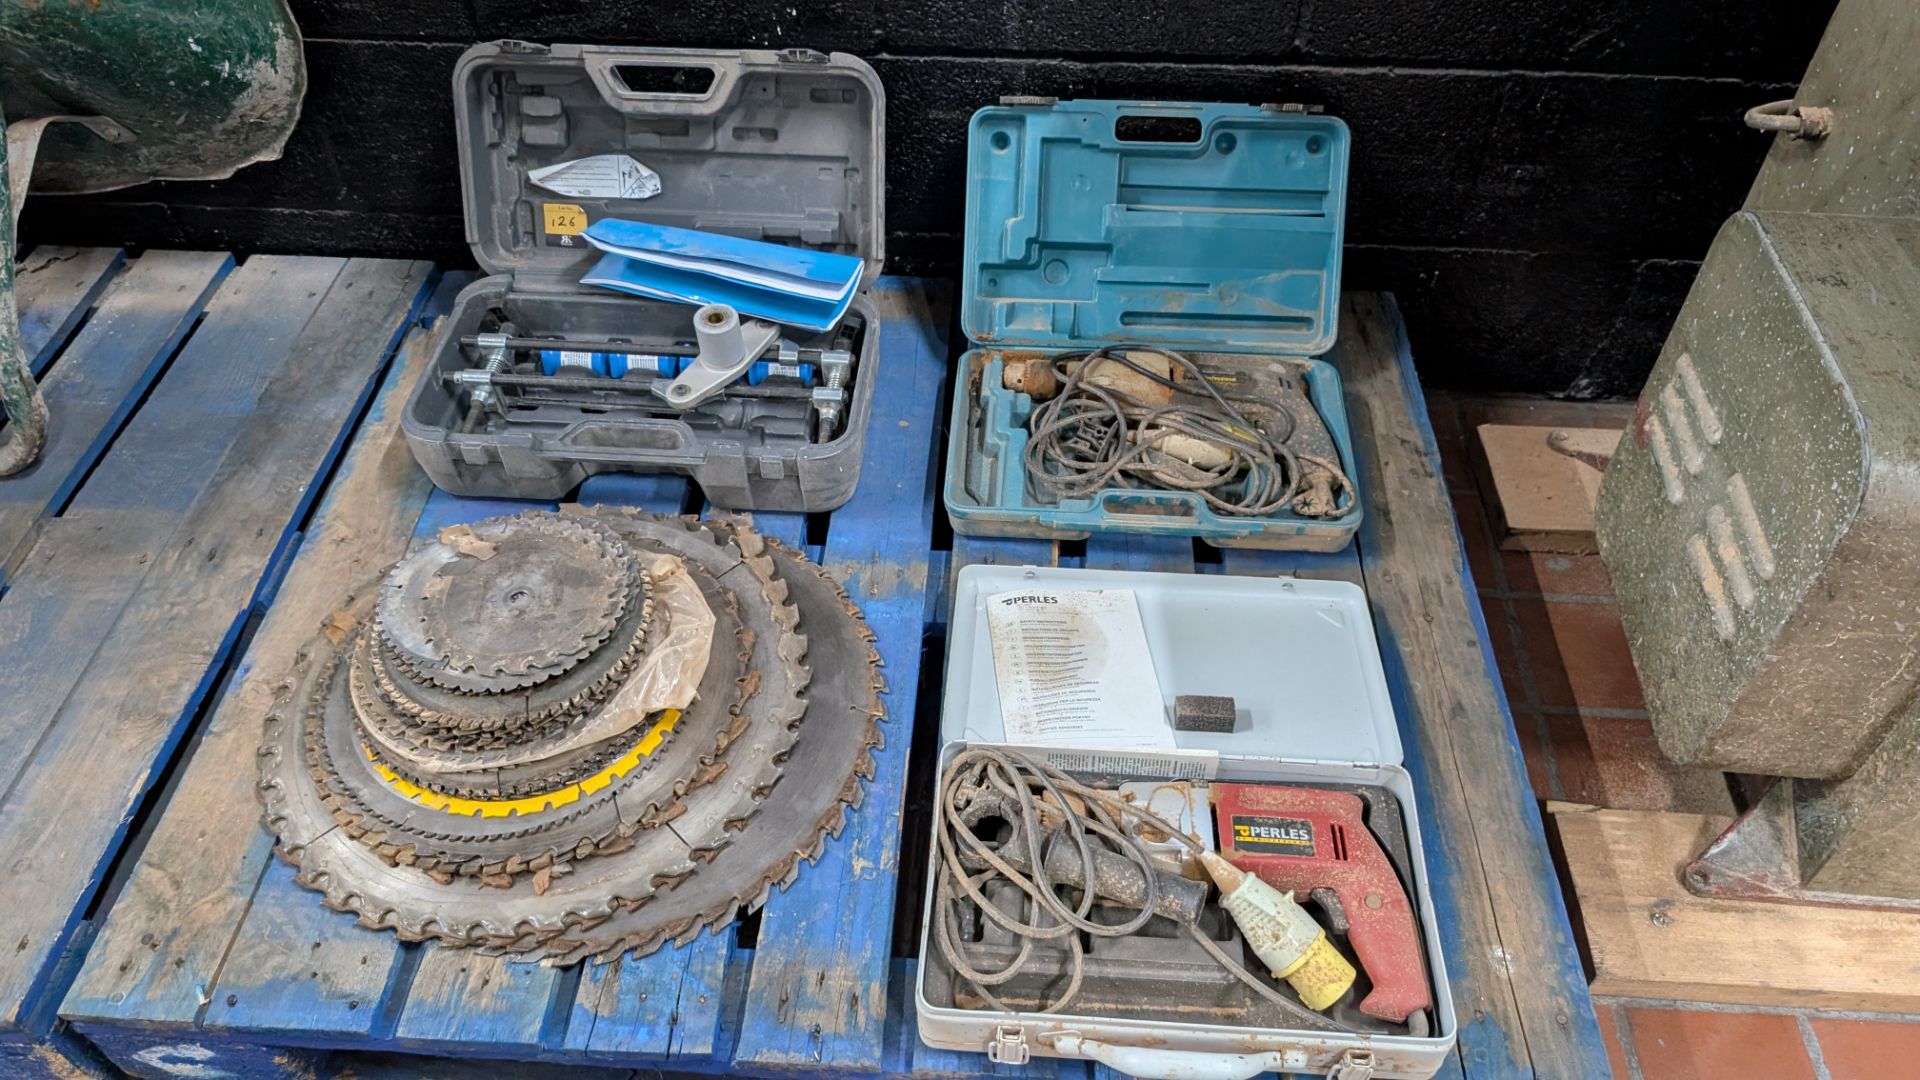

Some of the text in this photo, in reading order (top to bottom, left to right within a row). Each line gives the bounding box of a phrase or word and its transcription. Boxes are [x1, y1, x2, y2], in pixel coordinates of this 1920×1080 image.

[552, 215, 576, 227] 126
[1013, 595, 1058, 604] PERLES
[1250, 826, 1310, 840] PERLES
